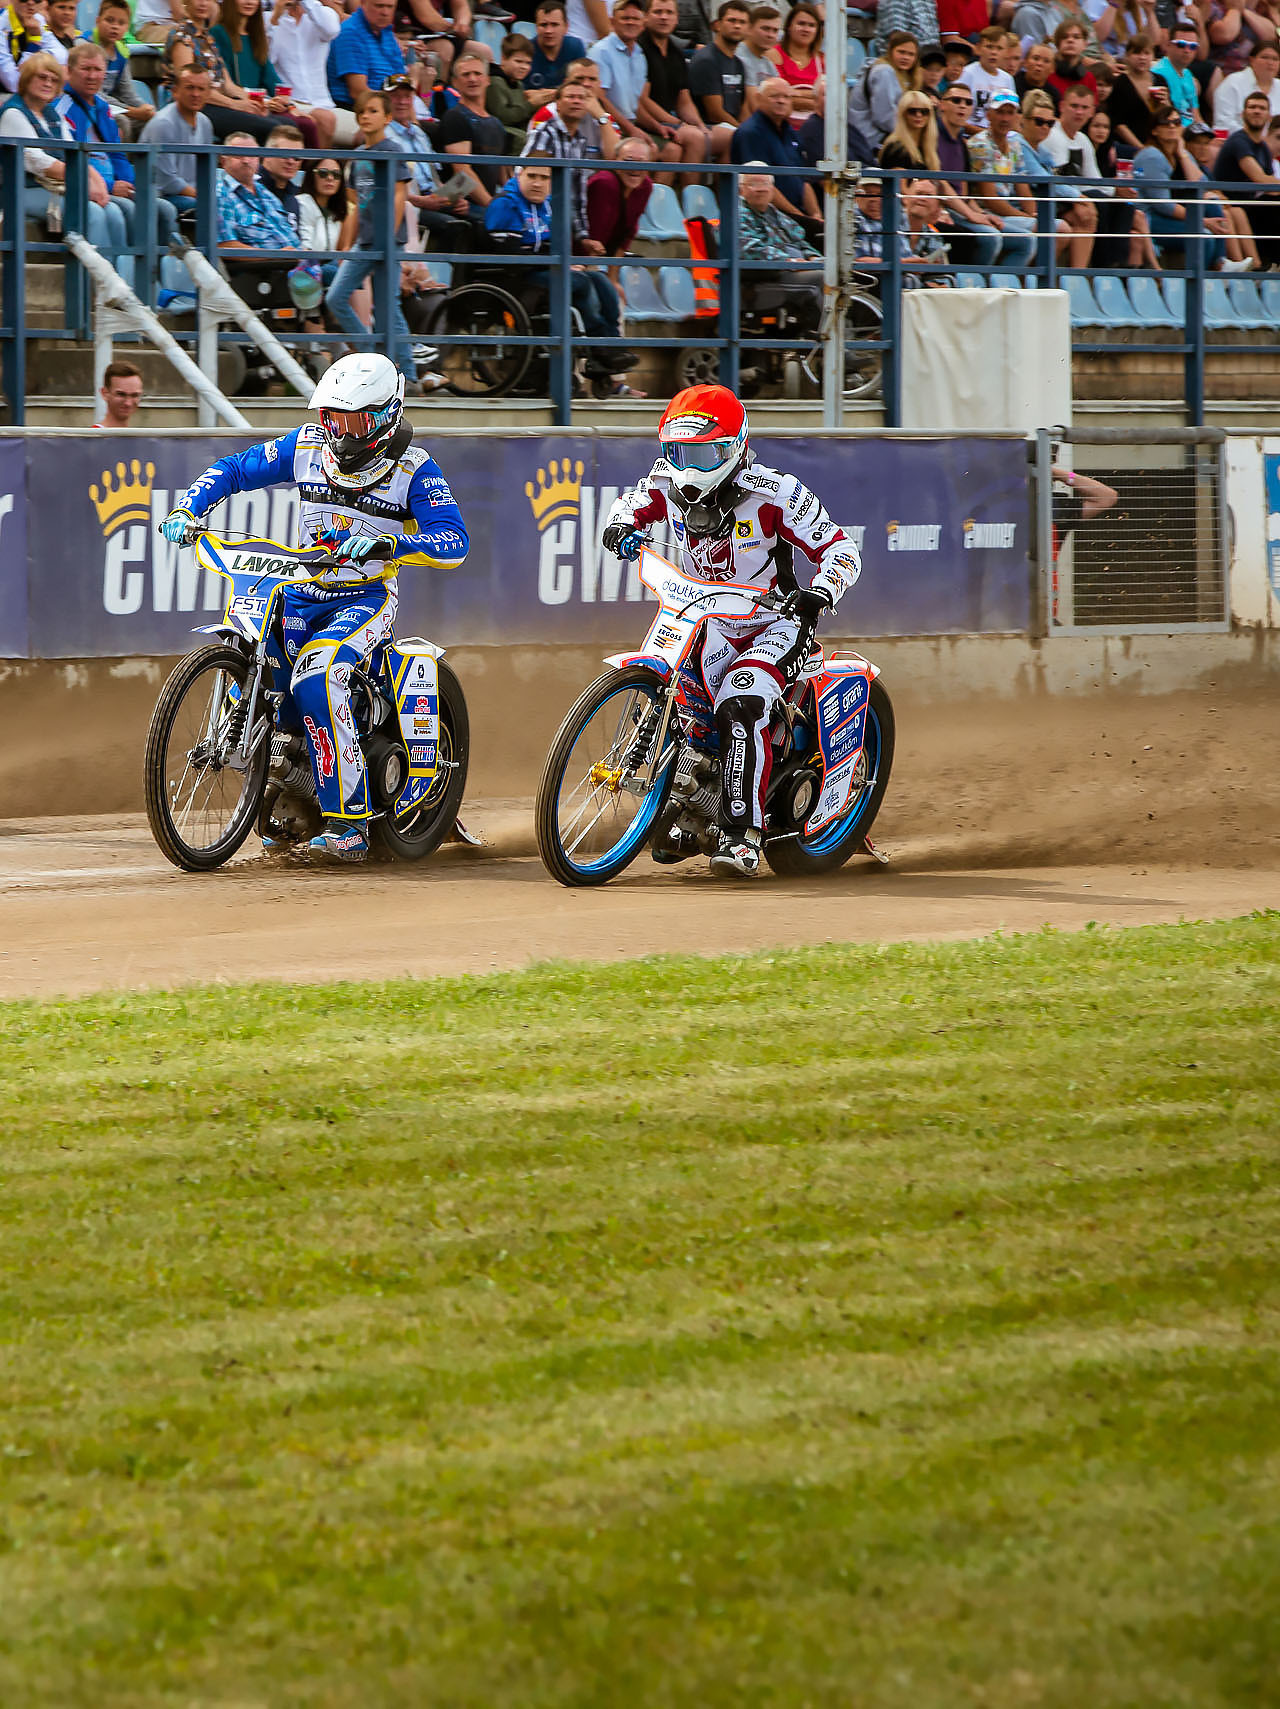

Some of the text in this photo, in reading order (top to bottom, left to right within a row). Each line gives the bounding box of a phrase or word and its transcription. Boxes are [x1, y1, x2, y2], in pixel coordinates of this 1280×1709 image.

[305, 426, 324, 436] FS
[232, 555, 299, 577] LAVOR
[233, 598, 266, 612] FST
[658, 628, 682, 641] ERGOSS
[733, 740, 745, 798] NORTH TYRES
